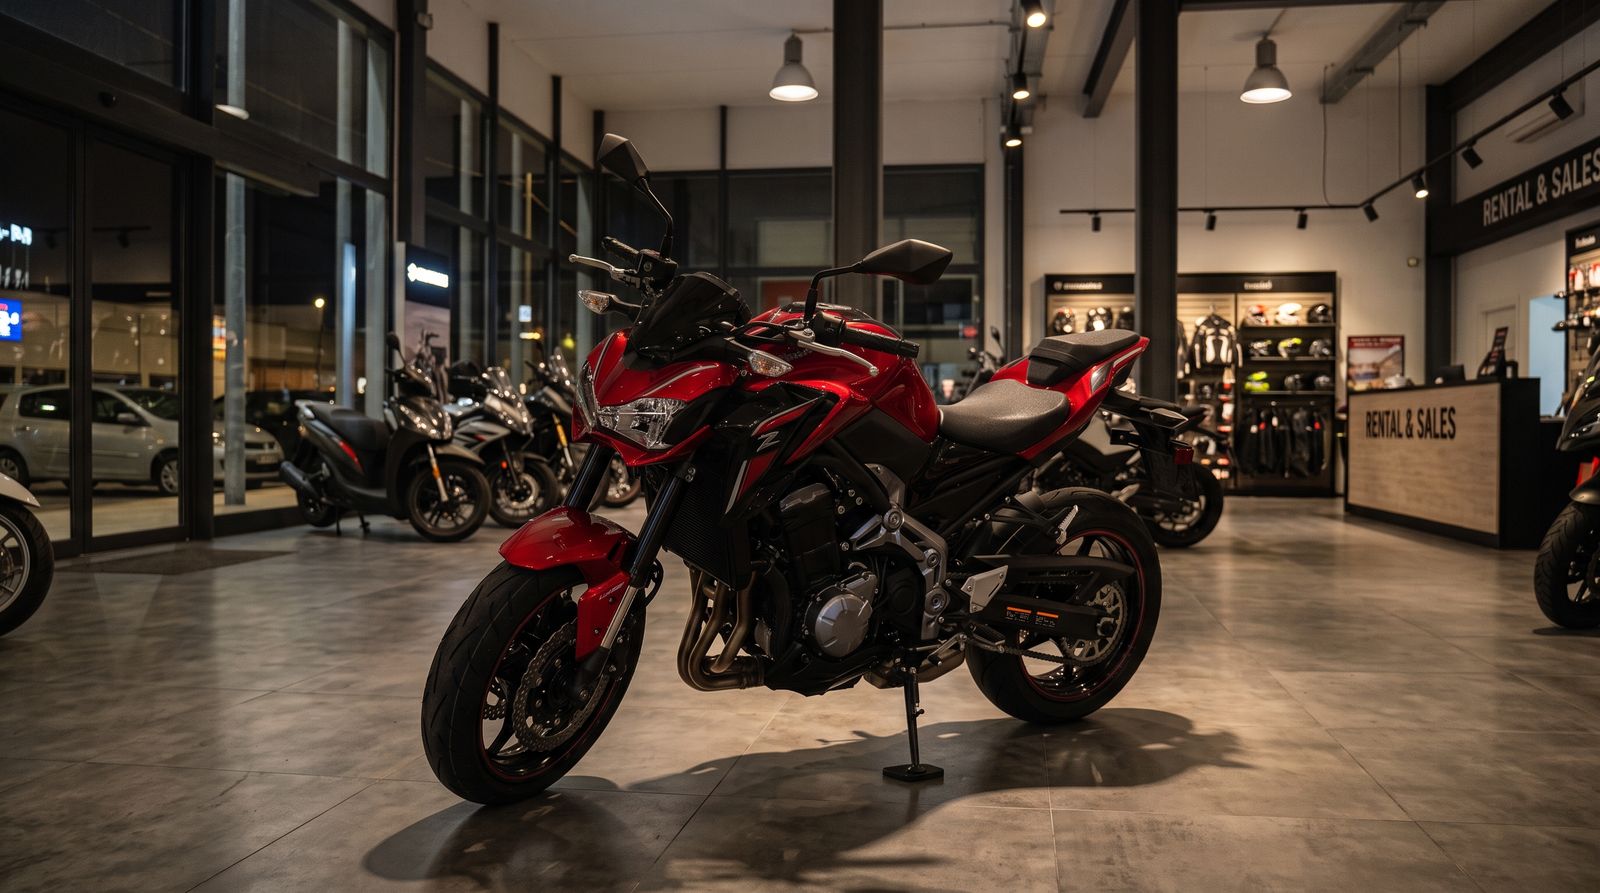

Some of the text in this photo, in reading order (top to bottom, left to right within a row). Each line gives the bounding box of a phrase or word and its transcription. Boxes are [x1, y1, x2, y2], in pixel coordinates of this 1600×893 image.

[1483, 147, 1600, 227] RENTAL & SALES
[1366, 406, 1456, 440] RENTAL & SALES
[757, 431, 780, 452] Z
